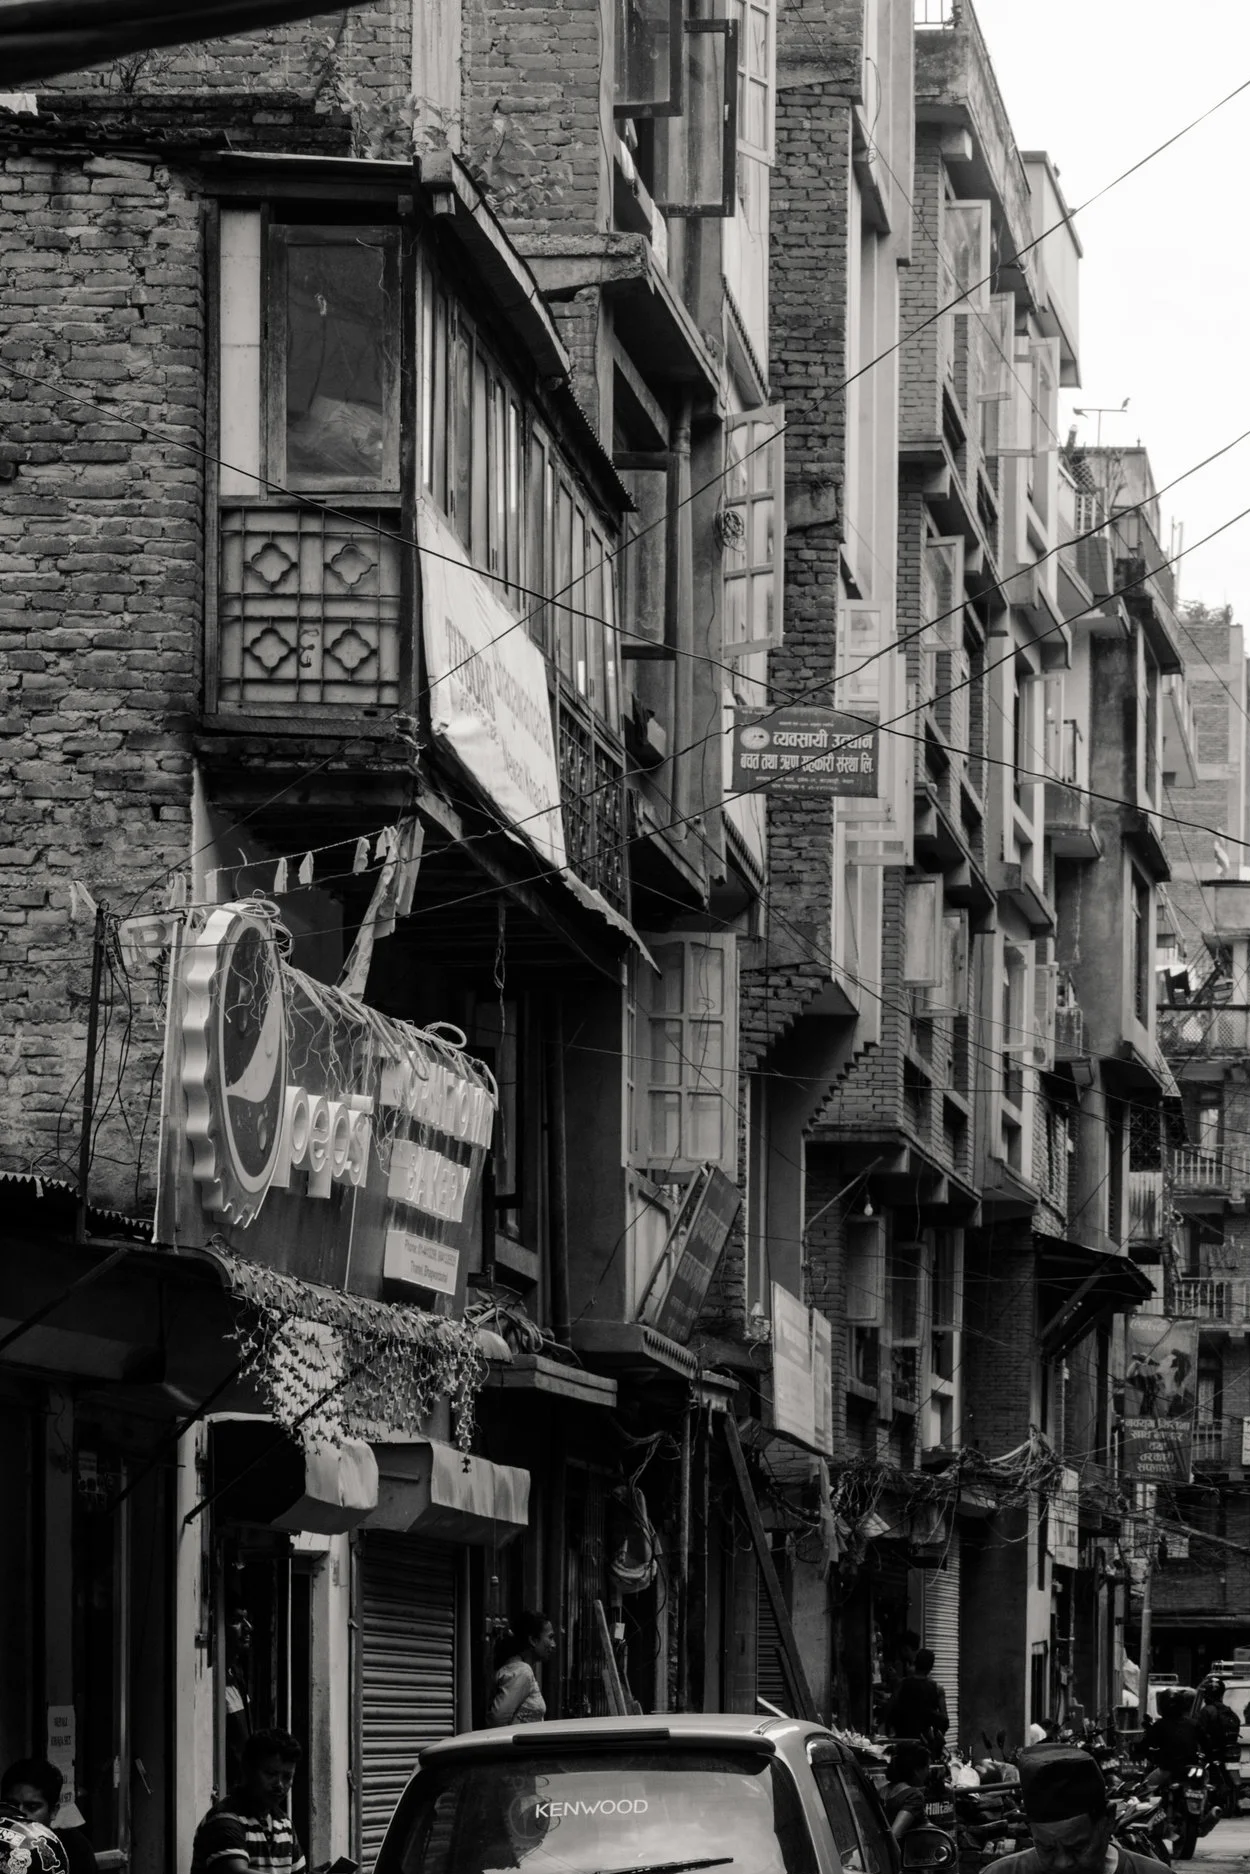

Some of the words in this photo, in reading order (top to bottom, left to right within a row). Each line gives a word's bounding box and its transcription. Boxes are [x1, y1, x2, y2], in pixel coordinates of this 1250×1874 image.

[773, 728, 828, 749] व्यवसायी
[740, 753, 760, 769] बचत
[761, 754, 779, 770] तथा
[780, 755, 800, 770] ऋण
[801, 753, 835, 773] सहकारी
[837, 755, 860, 773] संस्था
[860, 752, 874, 774] लि.
[535, 1799, 650, 1819] KENWOOD
